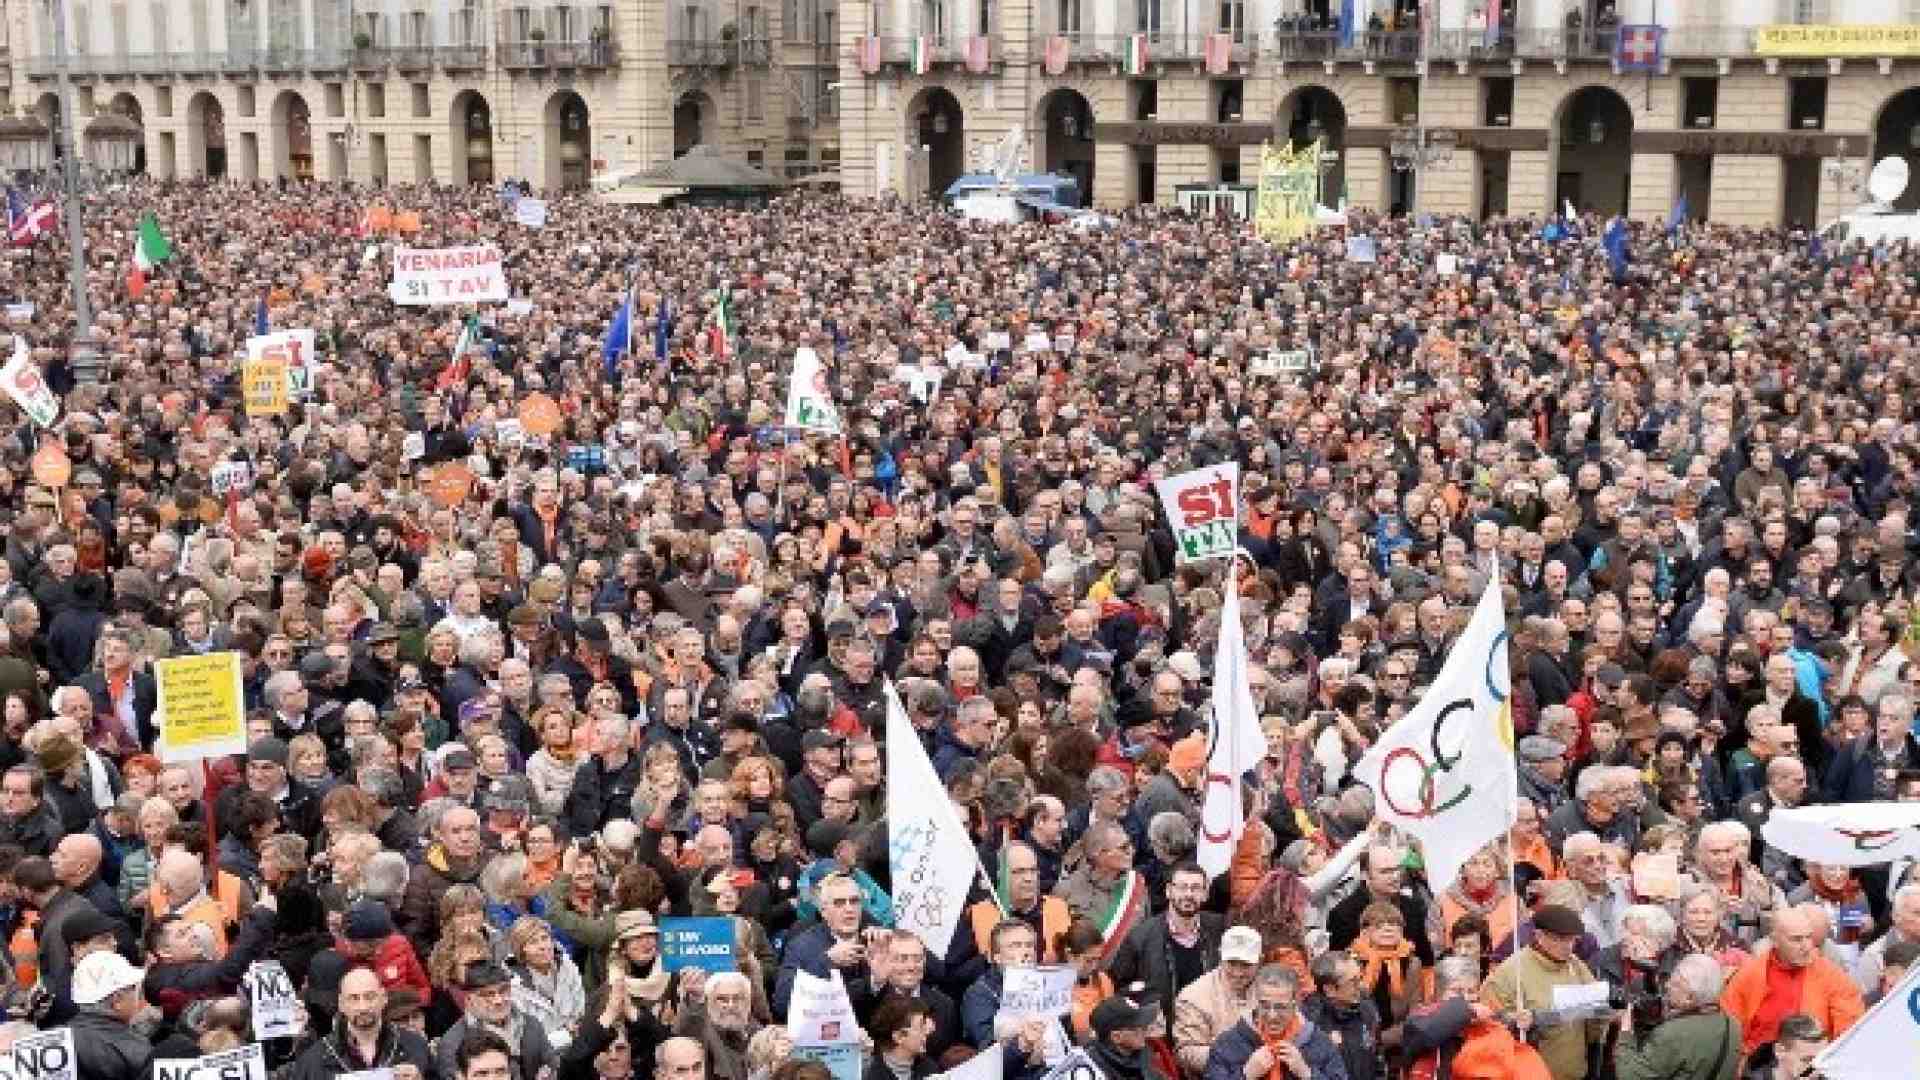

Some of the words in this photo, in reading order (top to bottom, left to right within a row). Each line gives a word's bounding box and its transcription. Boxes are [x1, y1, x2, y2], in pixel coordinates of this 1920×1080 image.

[397, 249, 498, 271] VENARIA
[440, 276, 492, 297] TAV
[1178, 519, 1234, 558] TAV
[15, 1045, 68, 1078] NO
